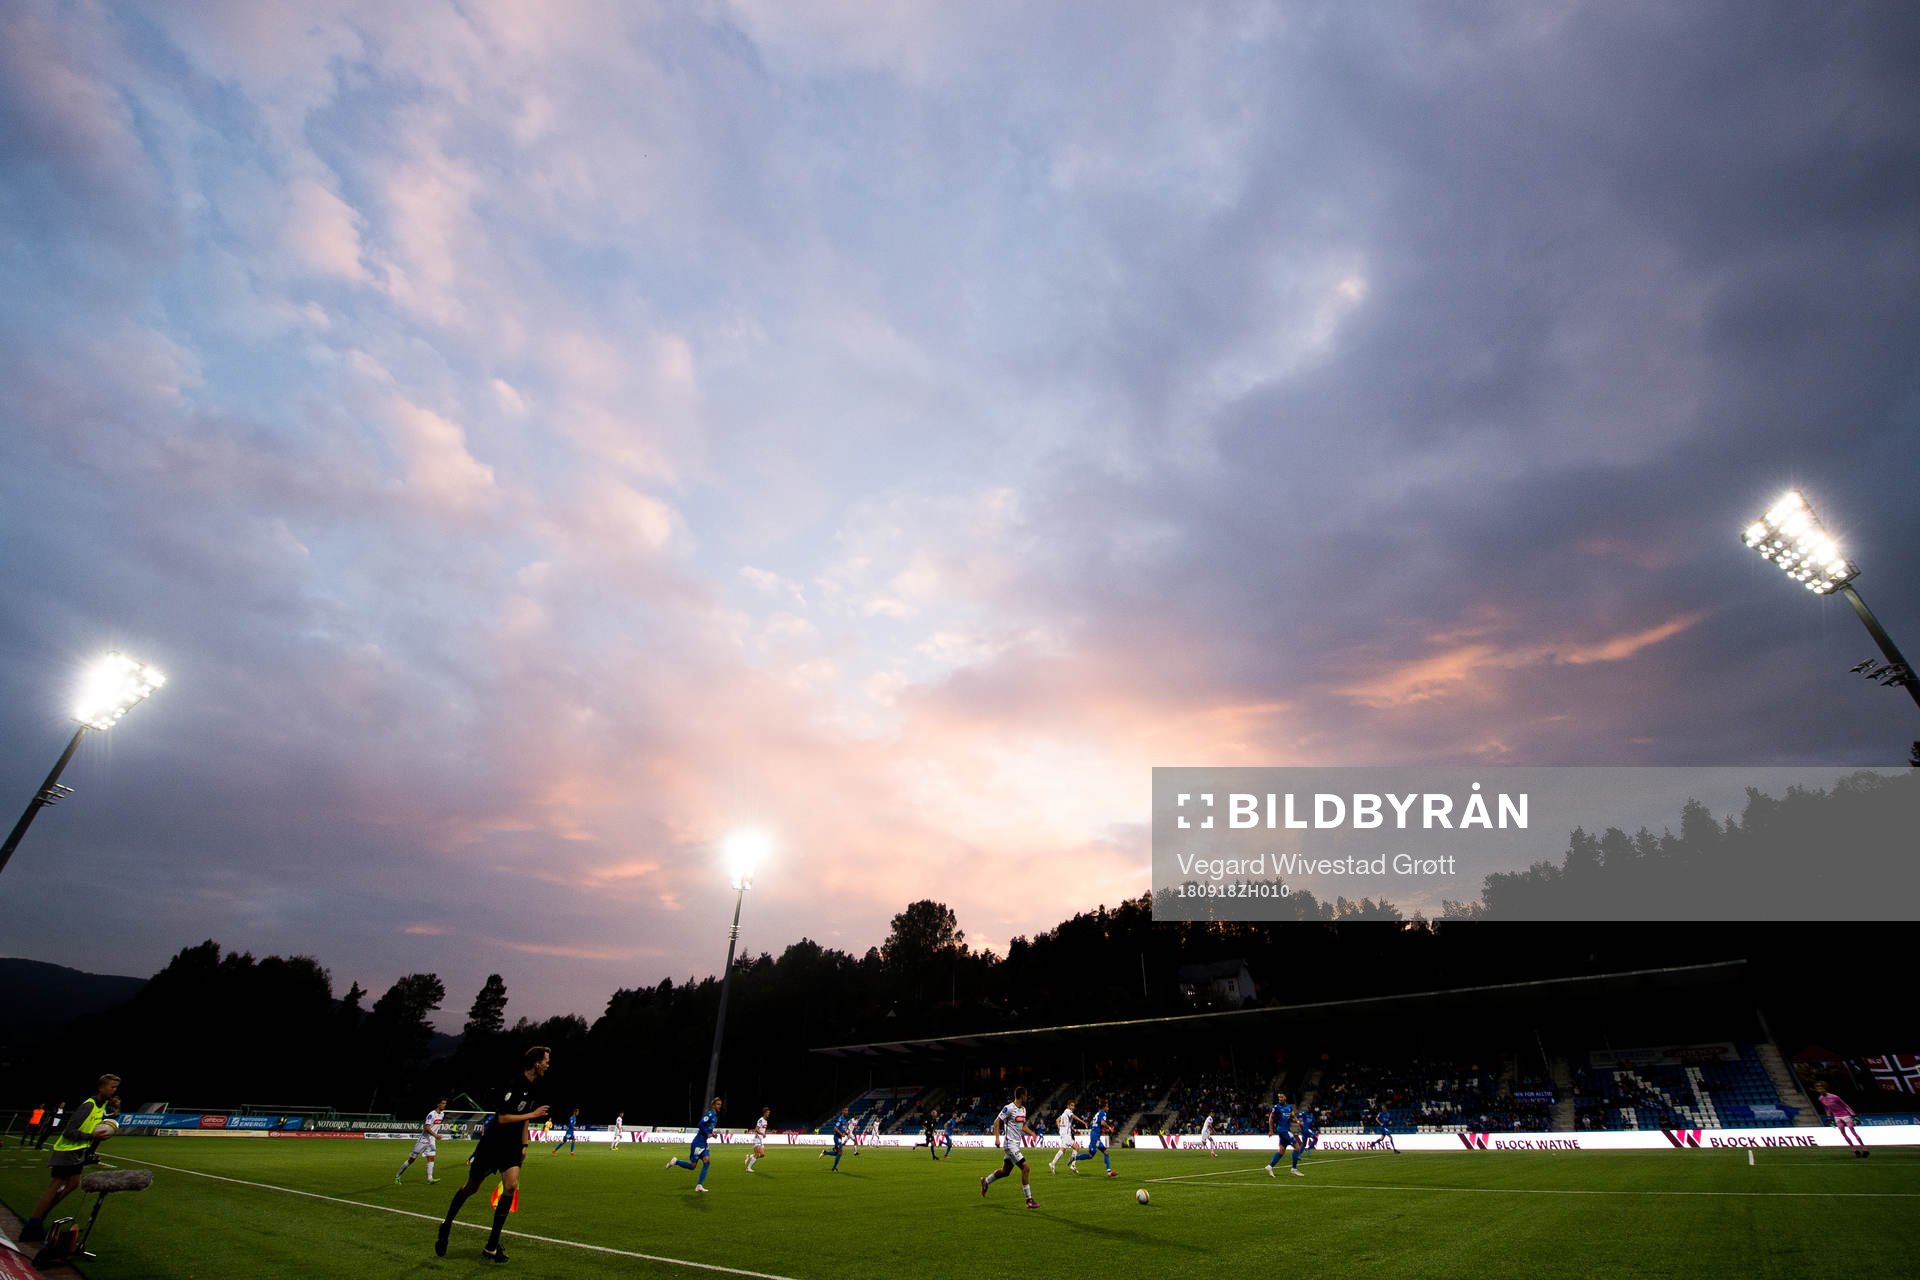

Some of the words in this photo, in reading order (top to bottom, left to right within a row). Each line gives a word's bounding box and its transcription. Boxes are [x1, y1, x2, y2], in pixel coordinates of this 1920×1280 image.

[316, 1120, 350, 1129] NOTODDEN
[1865, 1117, 1909, 1126] Trading
[1323, 1141, 1354, 1150] BLOCK
[1495, 1140, 1535, 1150] BLOCK
[1536, 1139, 1580, 1150] WATNE
[1710, 1137, 1759, 1148] BLOCK
[1761, 1136, 1819, 1148] WATNE
